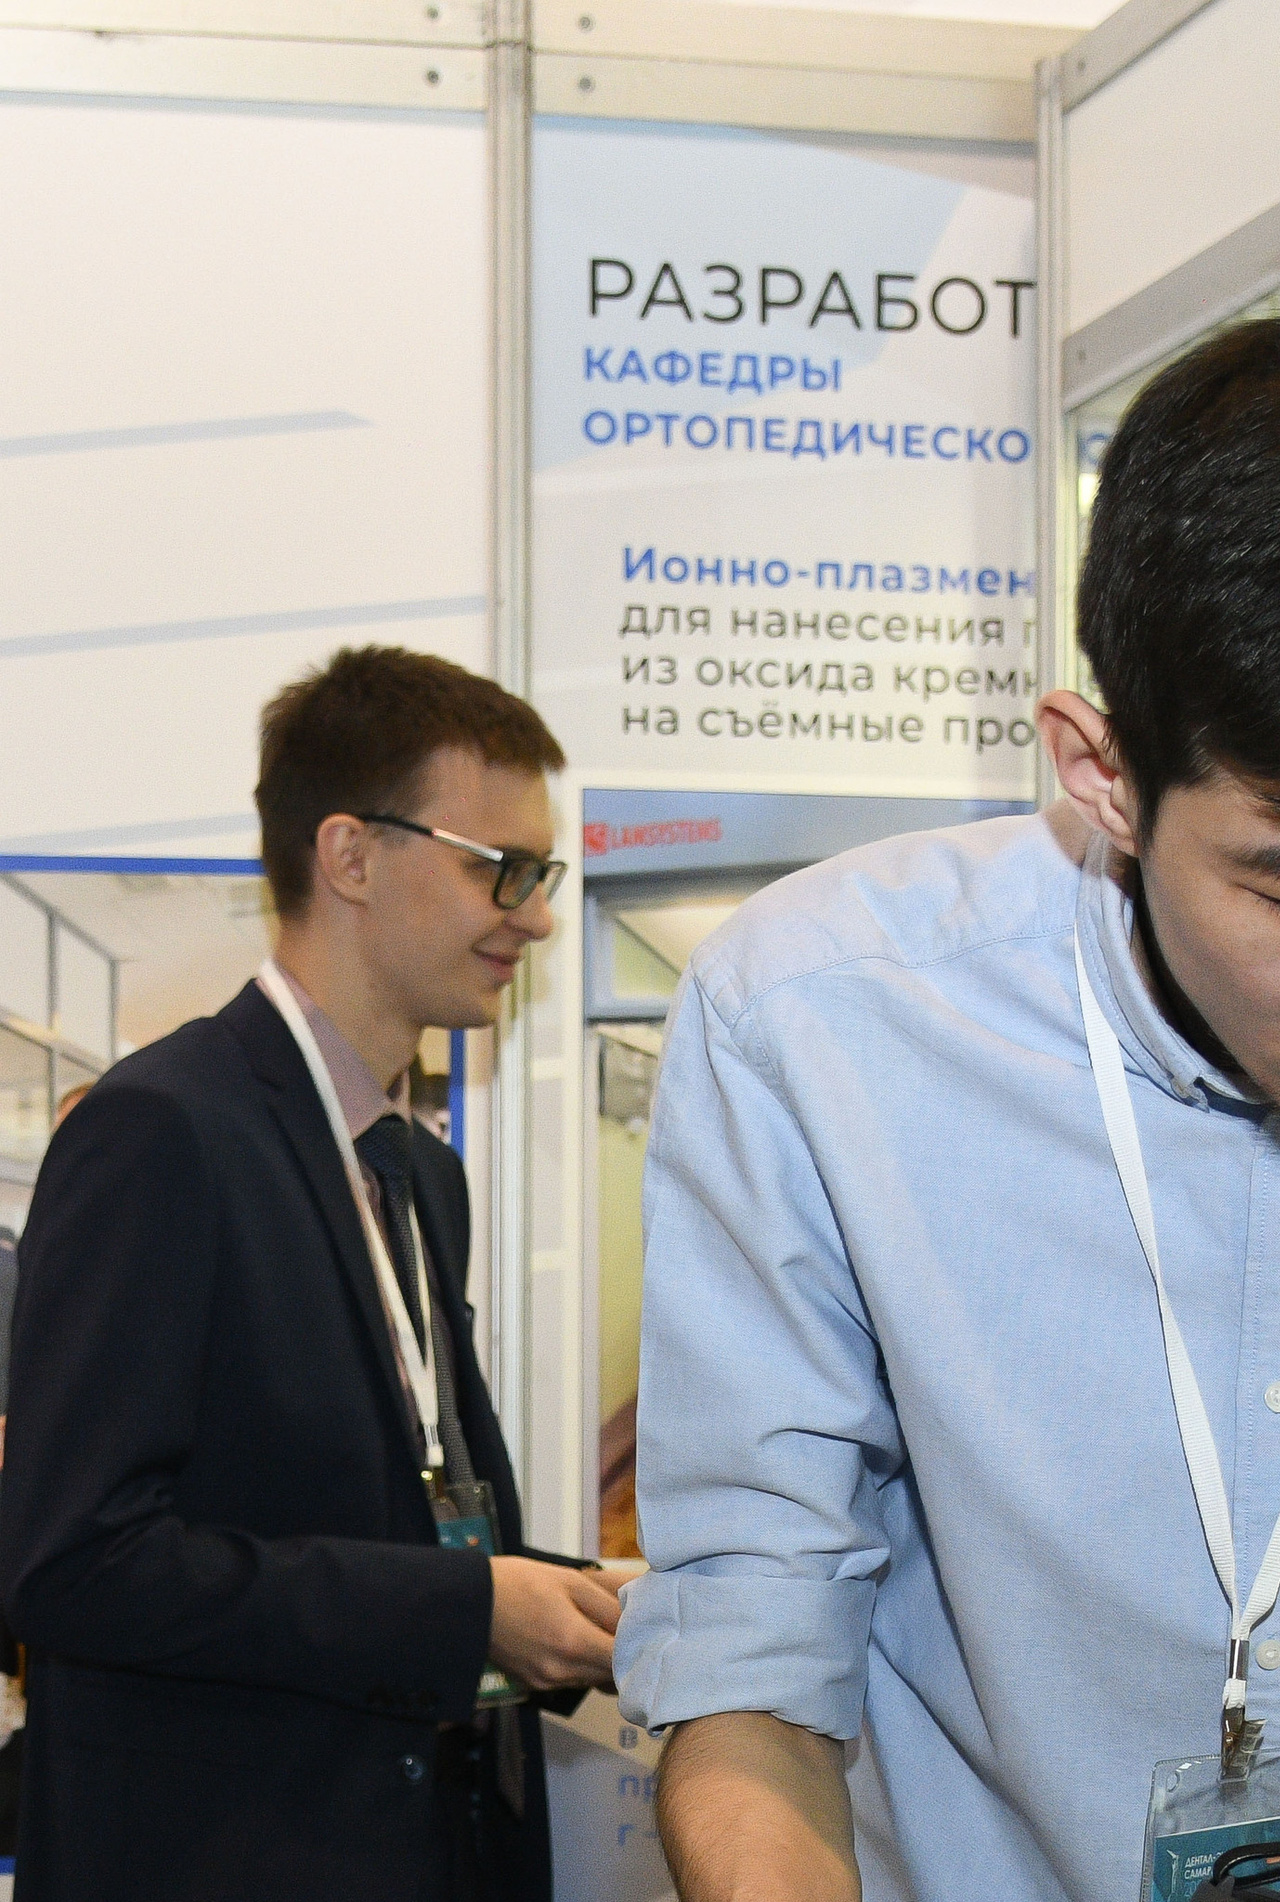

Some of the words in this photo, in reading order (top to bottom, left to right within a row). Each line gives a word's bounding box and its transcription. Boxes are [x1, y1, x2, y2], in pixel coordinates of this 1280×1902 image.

[589, 258, 1037, 338] РАЗРАБОТ
[584, 346, 841, 395] КАФЕДРЫ
[582, 410, 1031, 463] ОРТОПЕДИЧЕСКО
[623, 546, 1035, 597] Ионно-плазмен
[618, 603, 711, 639] для
[730, 609, 1004, 647] нанесения
[622, 655, 678, 684] из
[695, 658, 874, 696] оксида
[621, 707, 680, 735] на
[697, 700, 924, 743] съёмные
[944, 715, 1036, 755] про
[1184, 1851, 1223, 1868] ДЕНТАЛ-
[1184, 1866, 1213, 1880] САМАР
